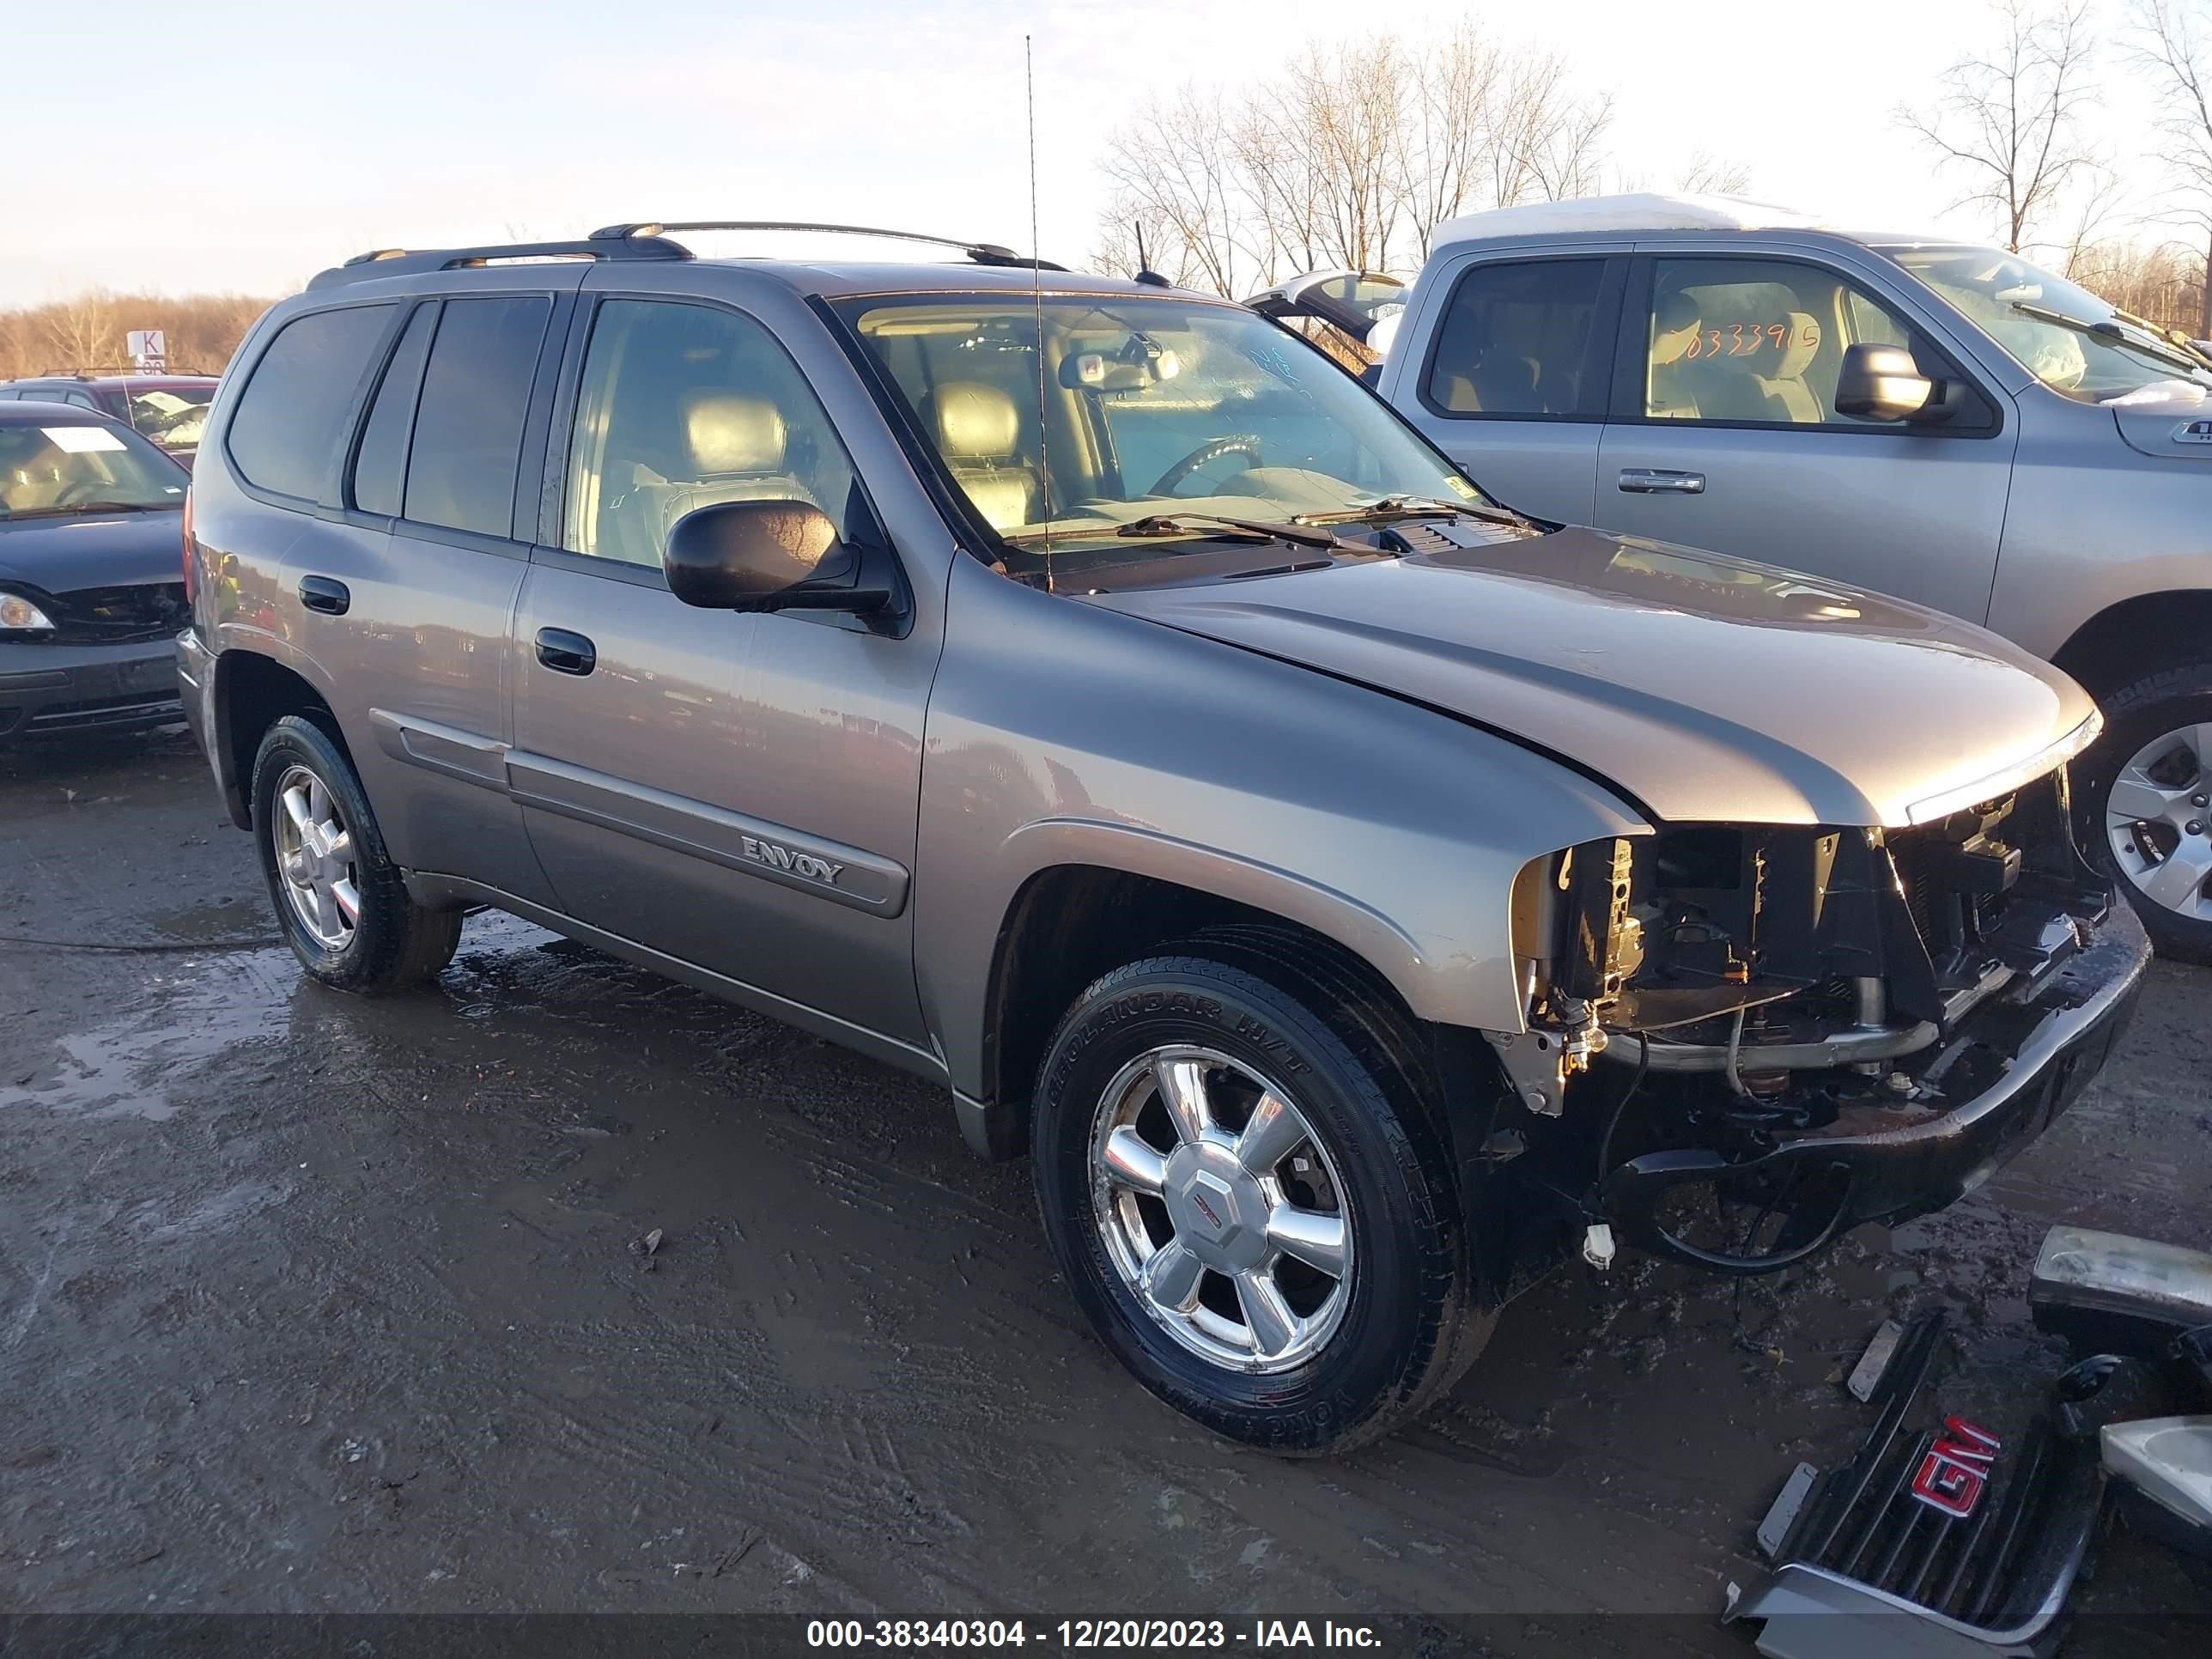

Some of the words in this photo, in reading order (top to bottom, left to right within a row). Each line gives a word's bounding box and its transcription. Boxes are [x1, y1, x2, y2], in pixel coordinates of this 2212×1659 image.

[144, 332, 159, 353] K
[741, 836, 845, 884] ENVOY
[1048, 991, 1223, 1108] GEOLANDAR
